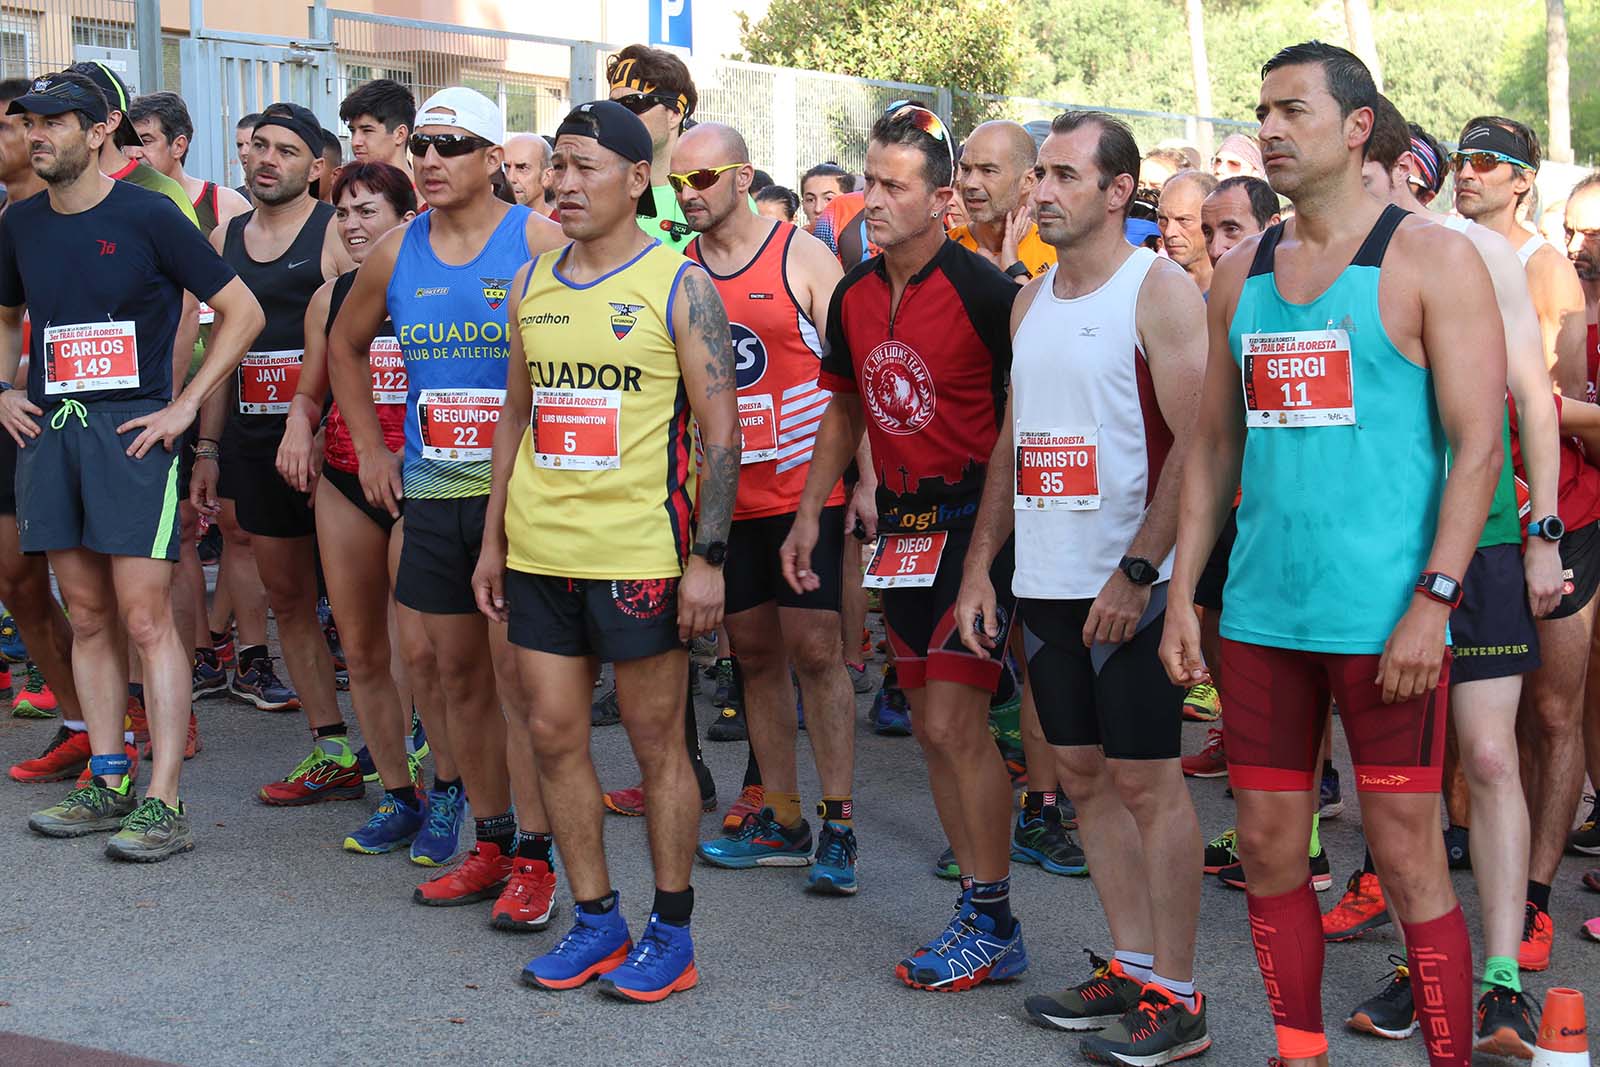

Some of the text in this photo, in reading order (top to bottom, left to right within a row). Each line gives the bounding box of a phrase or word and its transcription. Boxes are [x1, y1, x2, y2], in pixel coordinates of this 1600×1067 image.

[661, 0, 685, 42] P
[59, 331, 75, 339] TRAIL
[76, 330, 85, 338] DE
[85, 329, 92, 337] LA
[93, 328, 123, 336] FLORESTA
[60, 339, 124, 359] CARLOS
[433, 347, 449, 359] DE
[731, 337, 758, 370] S
[1260, 343, 1275, 352] TRAIL
[1276, 343, 1285, 352] DE
[1286, 342, 1296, 351] LA
[1297, 340, 1337, 351] FLORESTA
[73, 357, 112, 377] 149
[271, 356, 298, 364] FLORESTA
[871, 351, 884, 366] THE
[884, 346, 908, 362] LIONS
[906, 356, 926, 382] TEAM
[1267, 356, 1326, 379] SERGI
[256, 368, 286, 382] JAVI
[372, 371, 407, 389] 122
[266, 384, 278, 401] 2
[468, 396, 500, 404] FLORESTA
[543, 396, 557, 404] TRAIL
[565, 397, 573, 405] LA
[574, 397, 607, 406] FLORESTA
[1280, 381, 1312, 407] 11
[433, 408, 500, 423] SEGUNDO
[542, 414, 607, 425] LUIS WASHINGTON
[453, 426, 479, 446] 22
[564, 431, 577, 453] 5
[1037, 437, 1043, 445] DE
[1044, 437, 1051, 445] LA
[1051, 436, 1085, 445] FLORESTA
[1024, 450, 1088, 468] EVARISTO
[1040, 471, 1064, 494] 35
[896, 537, 932, 554] DIEGO
[896, 554, 919, 574] 15
[1410, 946, 1455, 1058] kalenji
